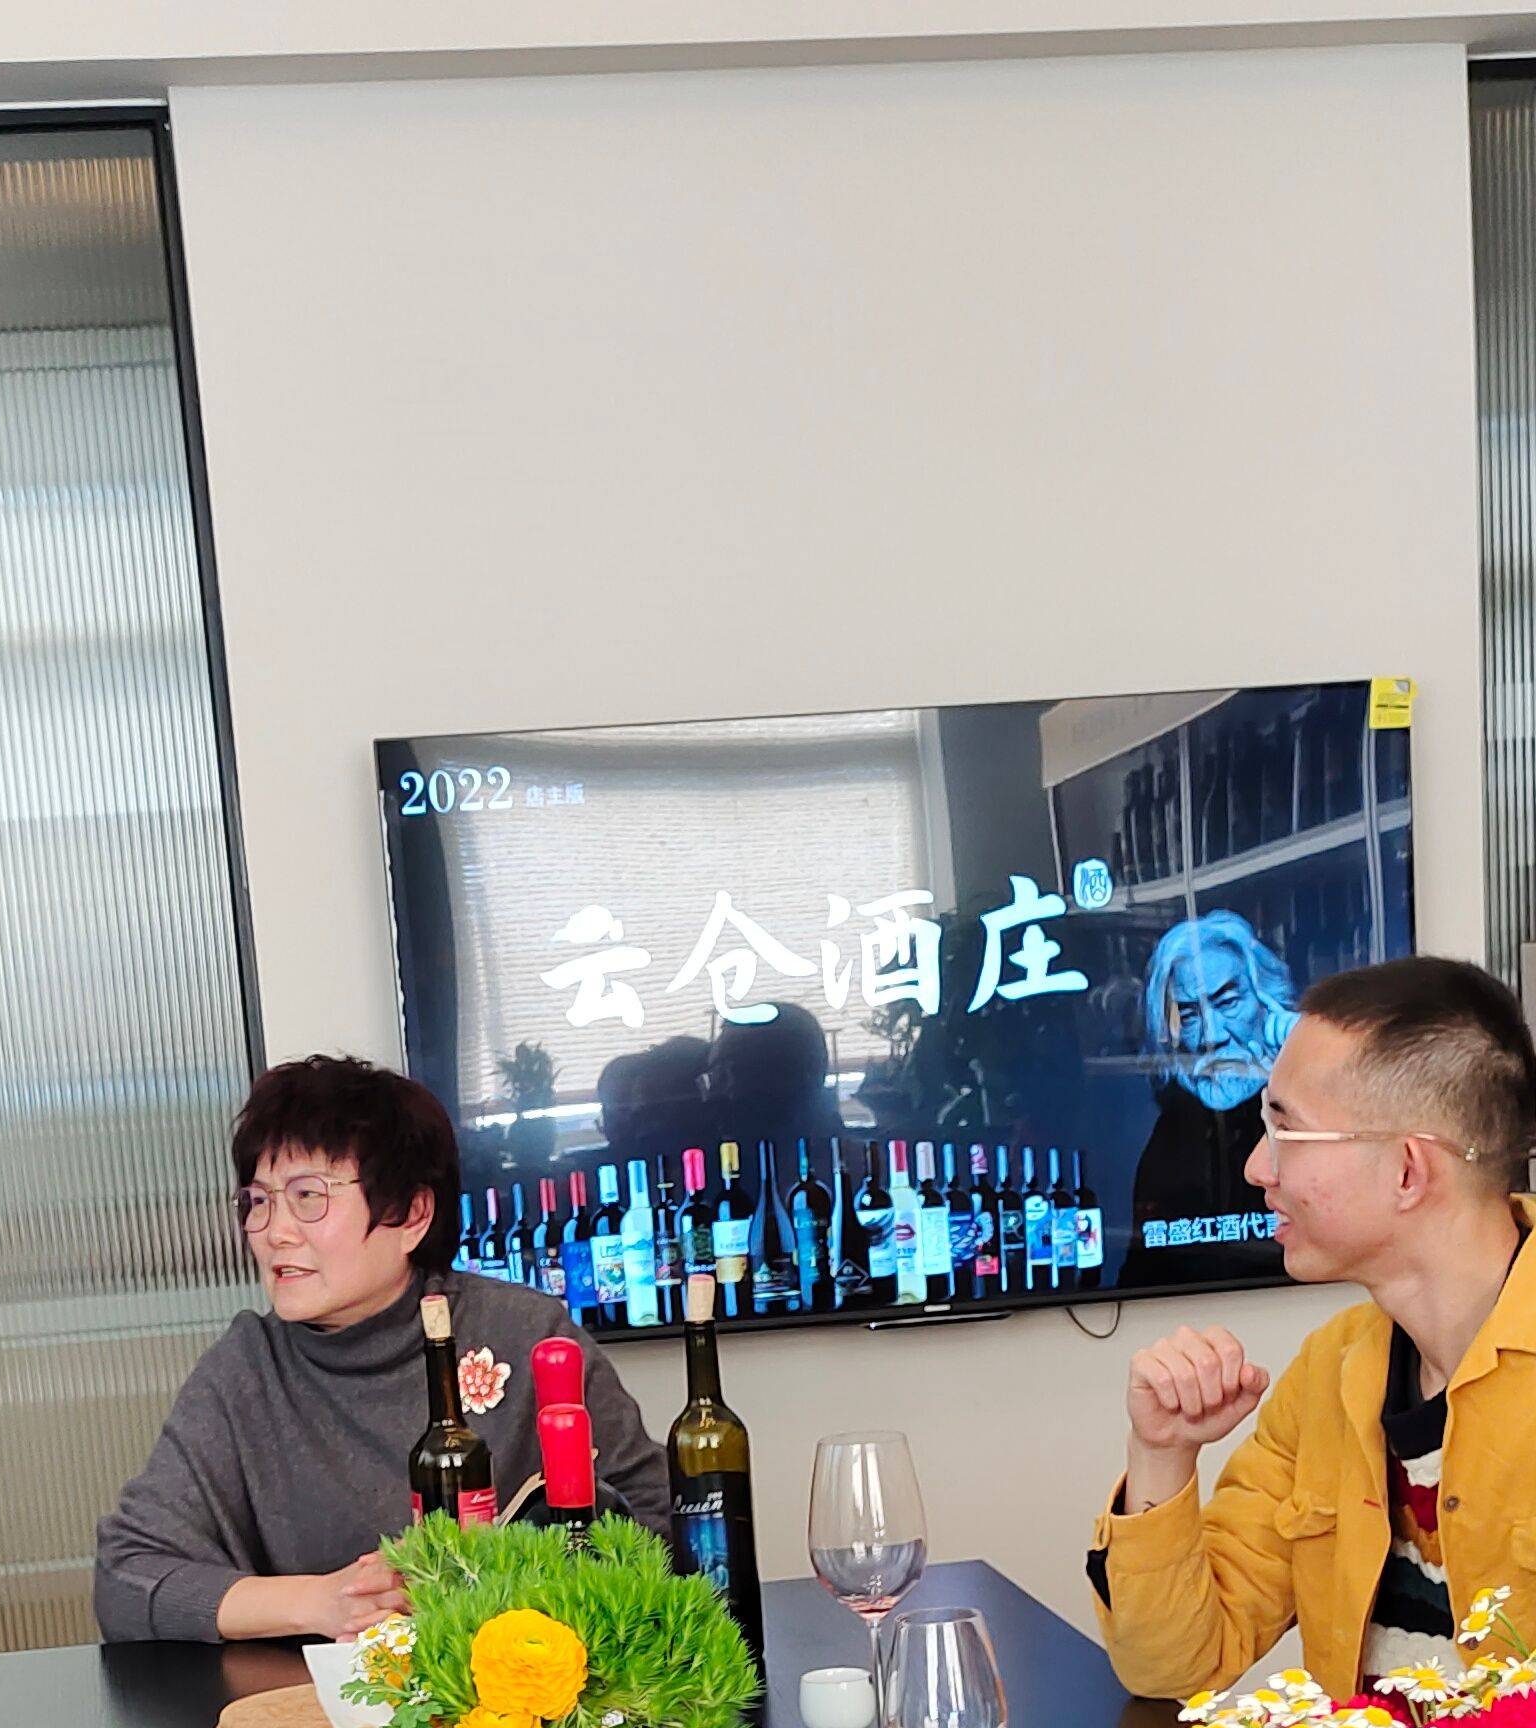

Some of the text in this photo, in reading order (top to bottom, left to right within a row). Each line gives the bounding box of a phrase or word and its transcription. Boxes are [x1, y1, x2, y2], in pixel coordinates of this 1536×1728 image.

[399, 765, 513, 816] 2022
[538, 875, 1089, 1028] 云仓酒庄
